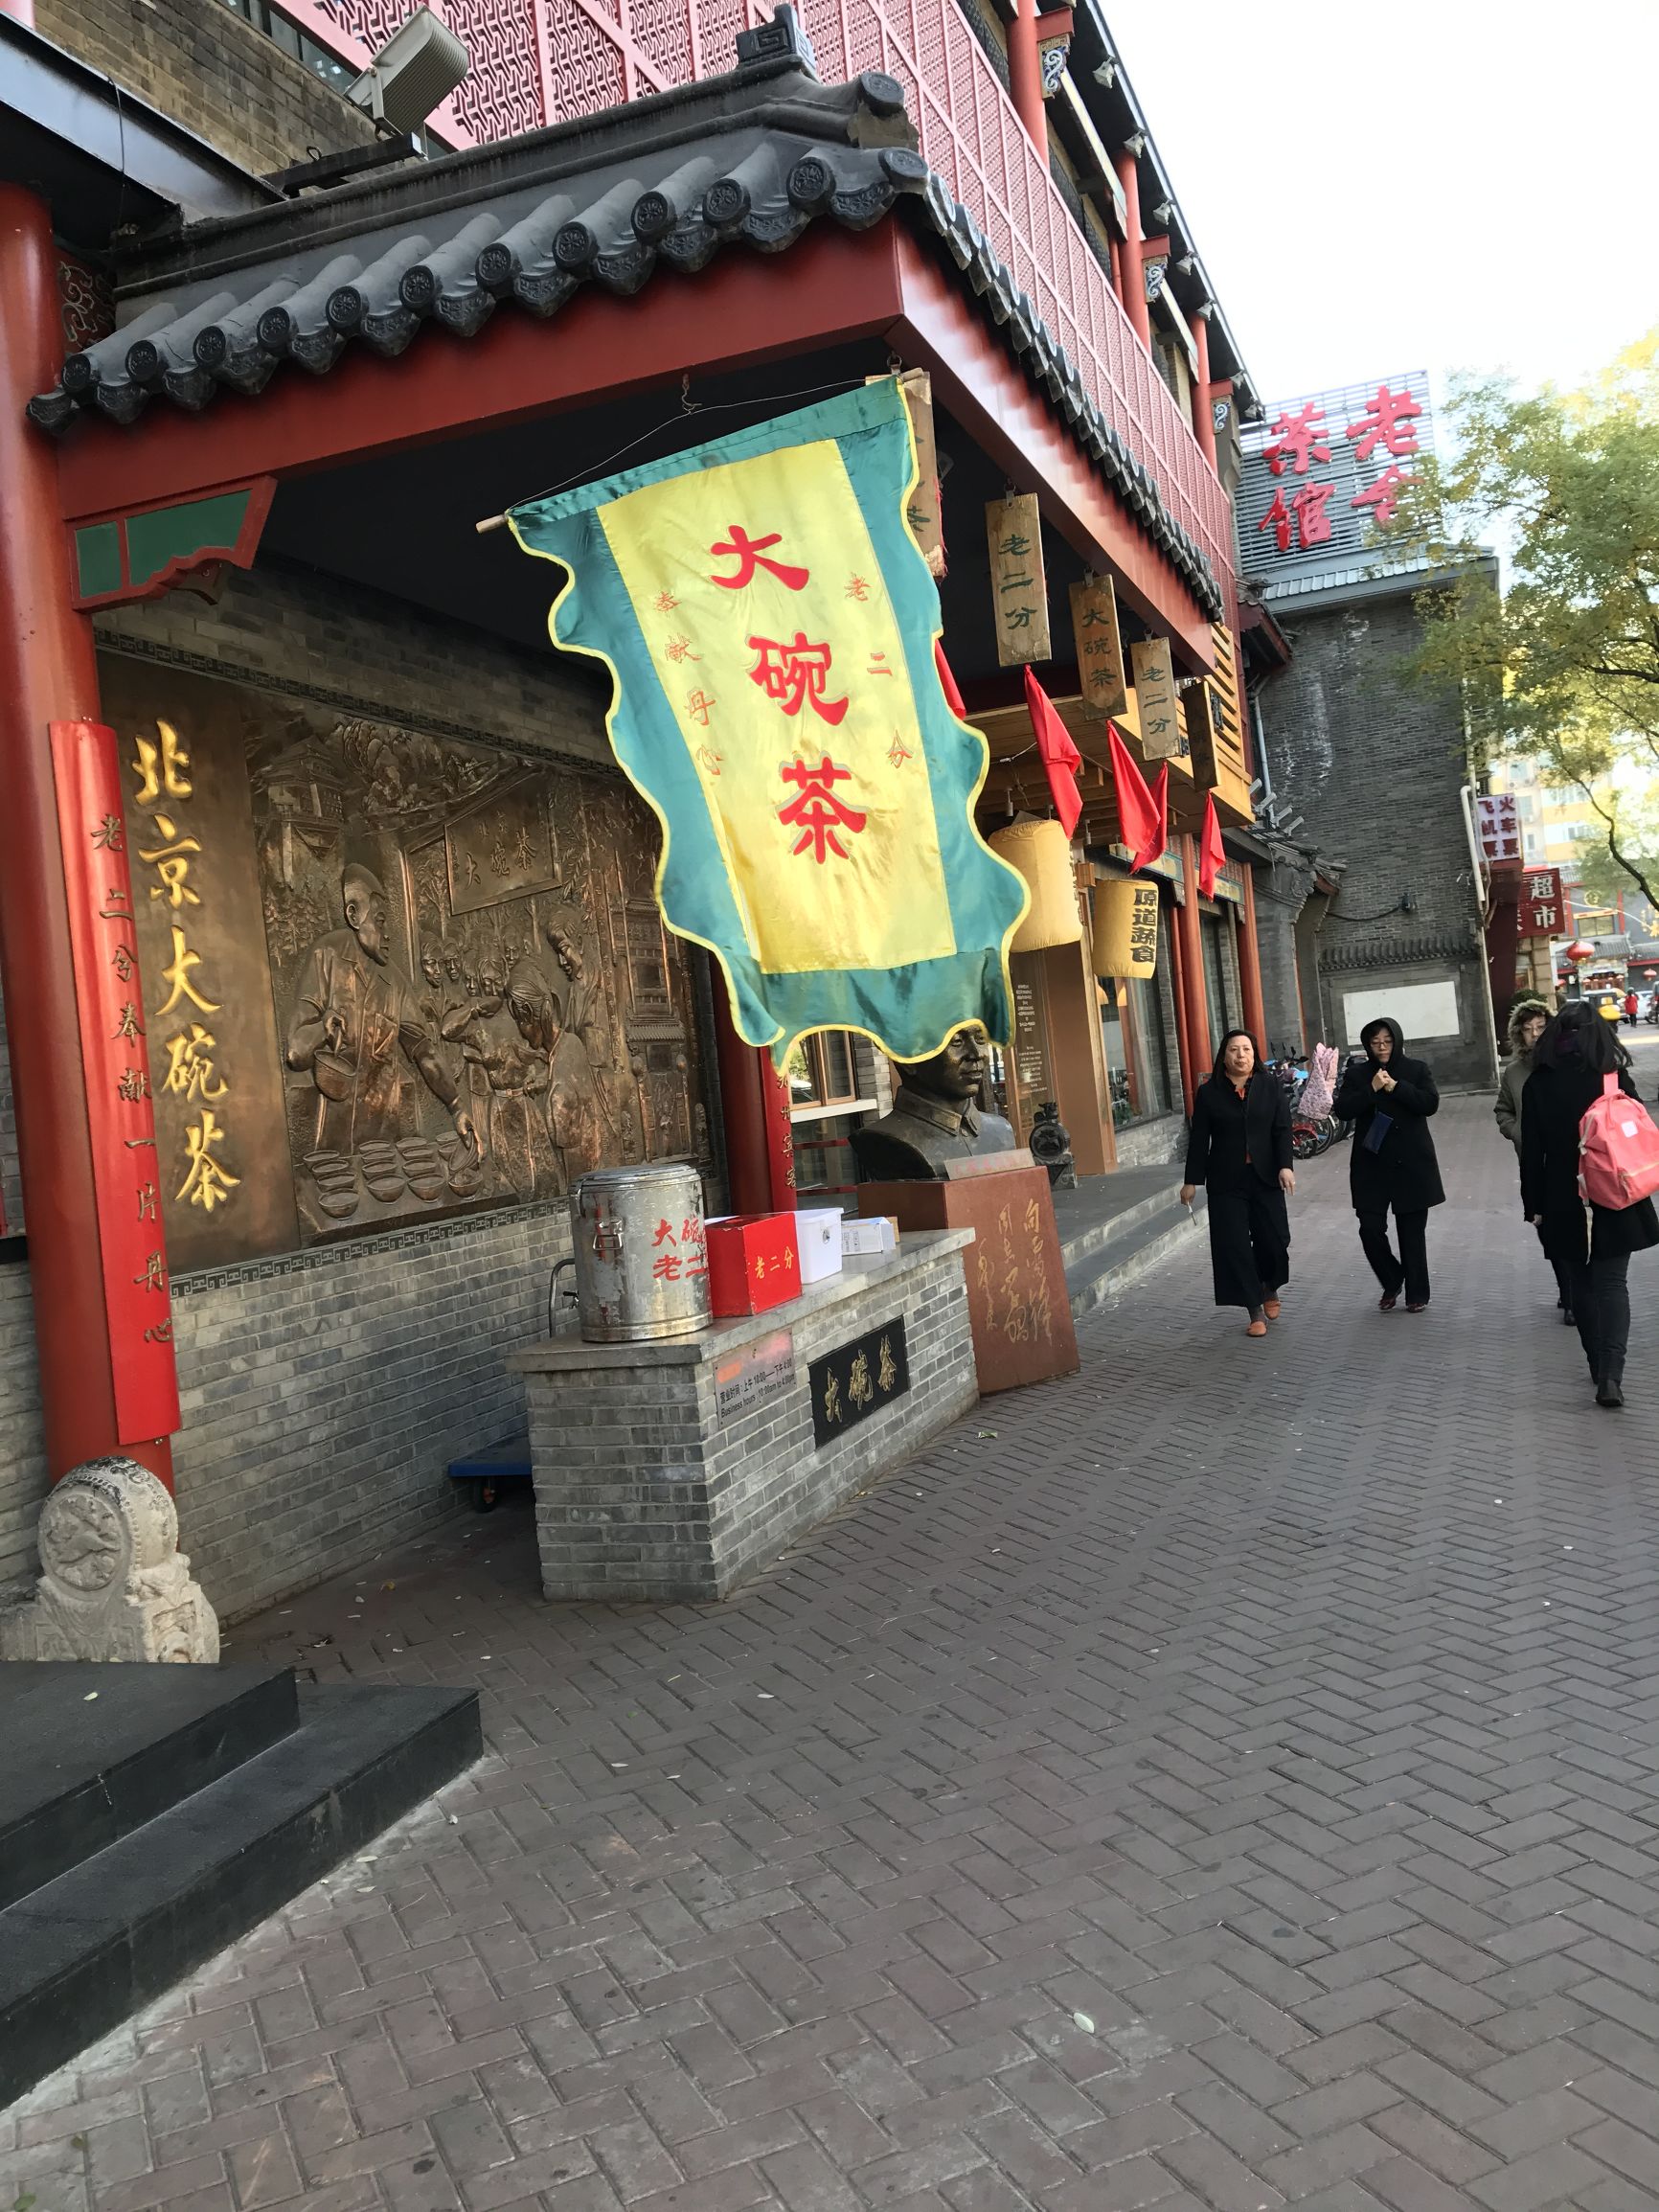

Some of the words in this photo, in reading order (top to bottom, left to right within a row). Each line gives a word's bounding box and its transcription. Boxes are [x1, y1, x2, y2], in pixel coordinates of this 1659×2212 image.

[1258, 400, 1336, 553] 茶馆
[998, 534, 1037, 629] 老二分
[845, 572, 913, 769] 老二分
[1081, 608, 1117, 688] 大碗茶
[710, 524, 868, 865] 大碗茶
[1141, 667, 1171, 735] 老二分
[1531, 875, 1557, 928] 超市
[132, 718, 240, 1212] 北京大碗茶
[755, 1246, 794, 1279] 老二分
[720, 1402, 743, 1418] Business
